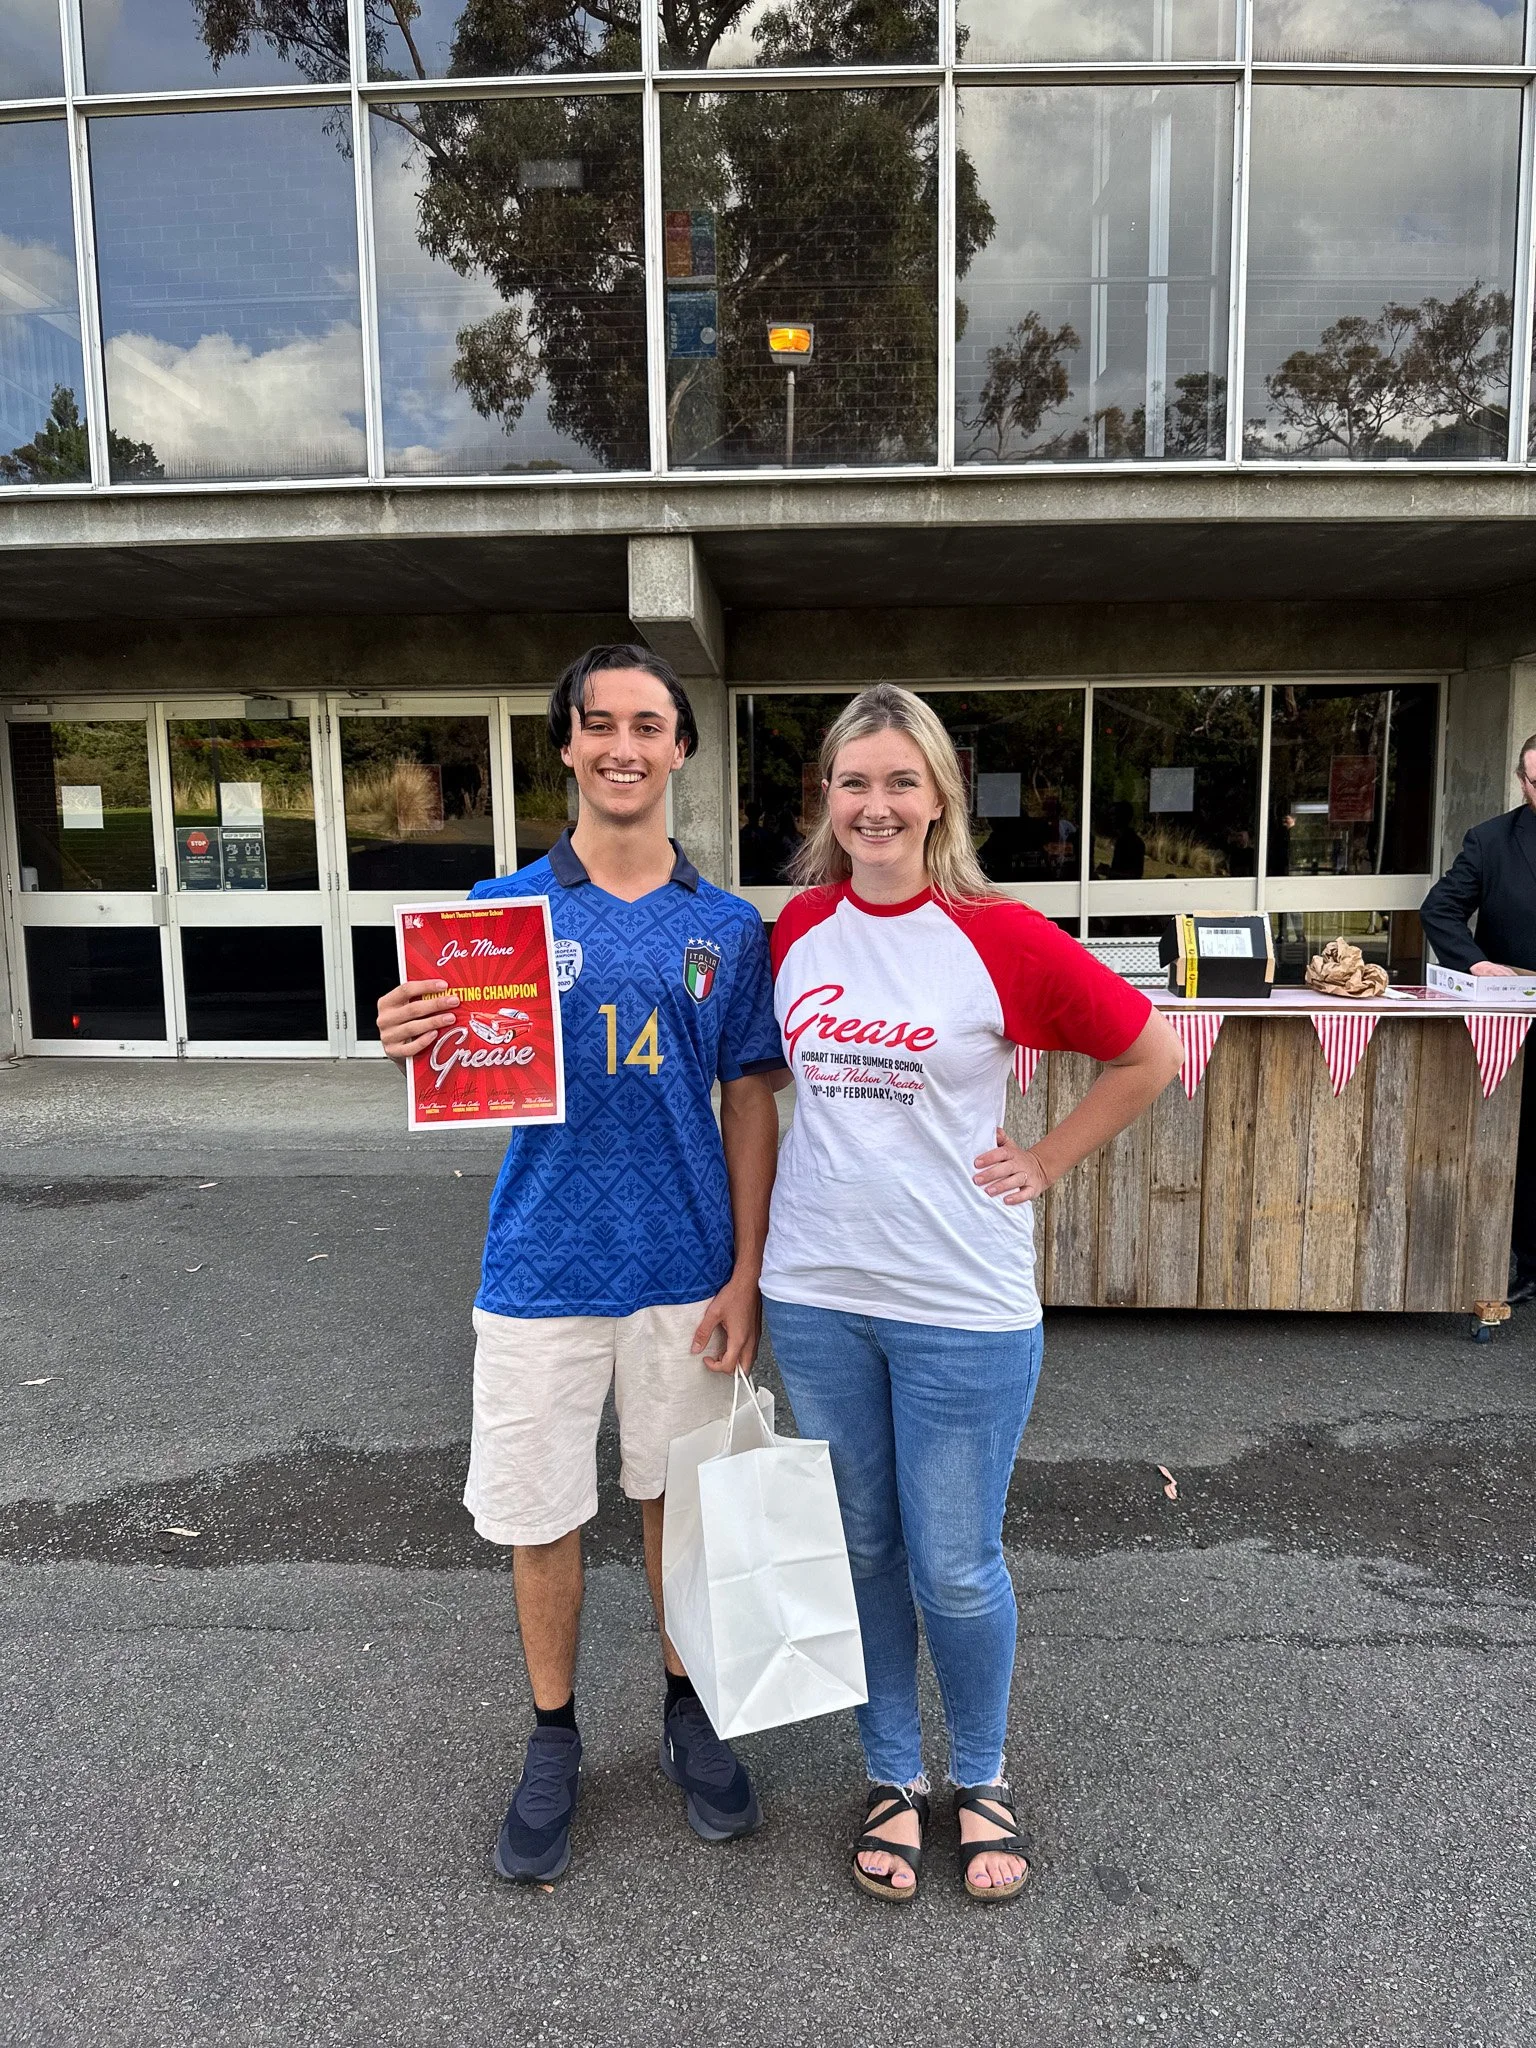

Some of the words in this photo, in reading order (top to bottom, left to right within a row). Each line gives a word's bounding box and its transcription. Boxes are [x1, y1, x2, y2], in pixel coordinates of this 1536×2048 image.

[437, 940, 469, 967] Joe
[470, 938, 514, 957] Mione
[554, 941, 572, 949] UEFA
[689, 952, 717, 967] ITALIA
[483, 983, 538, 1000] CHAMPION
[783, 984, 938, 1069] Grease
[598, 1004, 664, 1075] 14
[430, 1026, 536, 1090] Grease
[801, 1050, 829, 1062] HOBART
[830, 1053, 861, 1065] THEATRE
[862, 1055, 893, 1069] SUMMER
[894, 1060, 924, 1073] SCHOOL
[803, 1064, 841, 1082] Mount
[842, 1067, 881, 1083] Nelson
[882, 1071, 925, 1090] Theatre
[843, 1086, 893, 1101] FEBRUARY,
[894, 1090, 914, 1106] 2023
